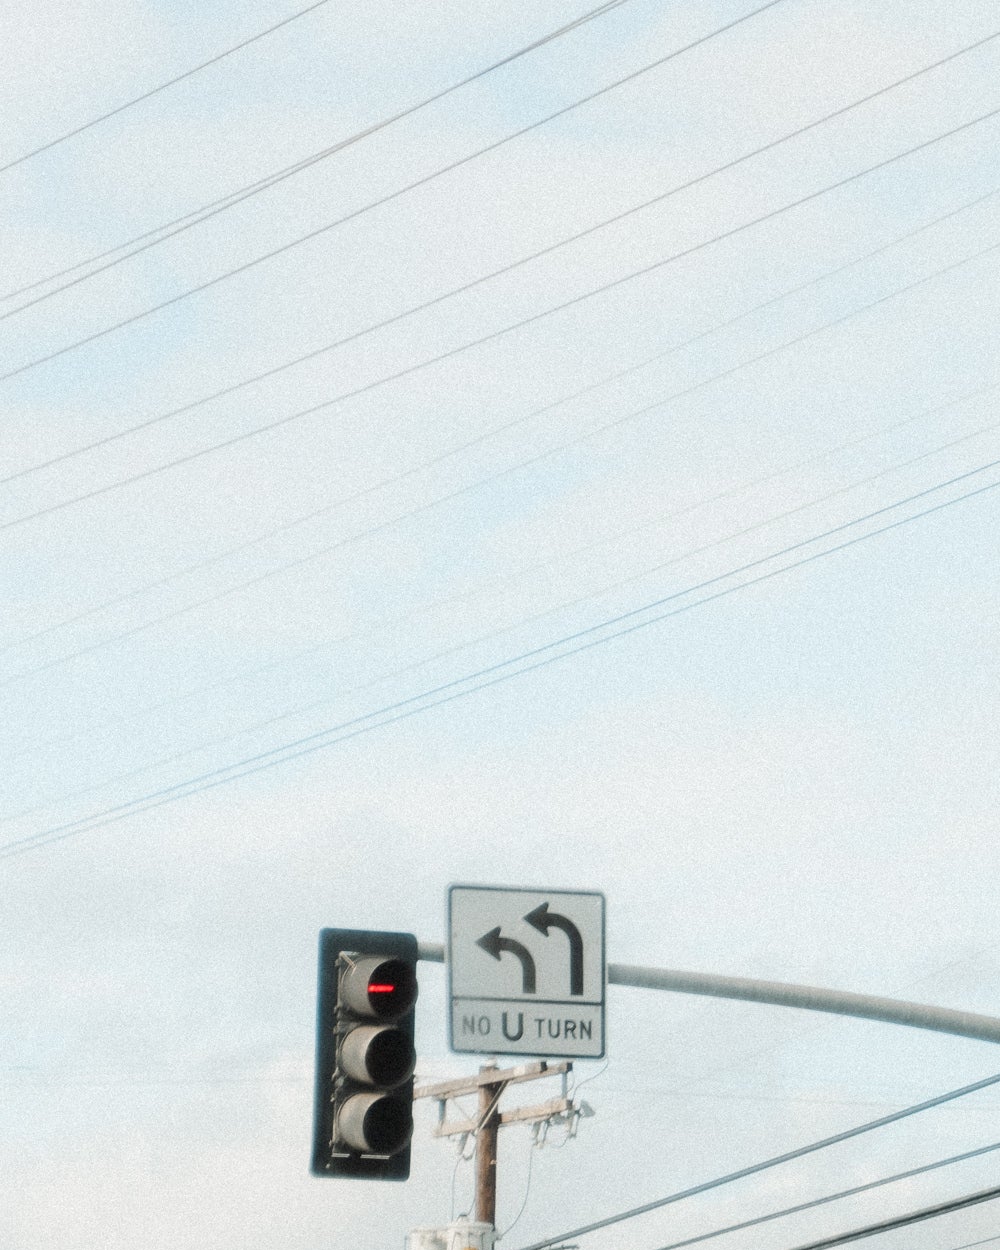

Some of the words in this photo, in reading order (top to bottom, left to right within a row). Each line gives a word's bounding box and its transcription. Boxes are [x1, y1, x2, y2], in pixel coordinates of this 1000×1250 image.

[462, 1015, 491, 1036] NO
[502, 1012, 524, 1042] U
[534, 1018, 592, 1040] TURN
